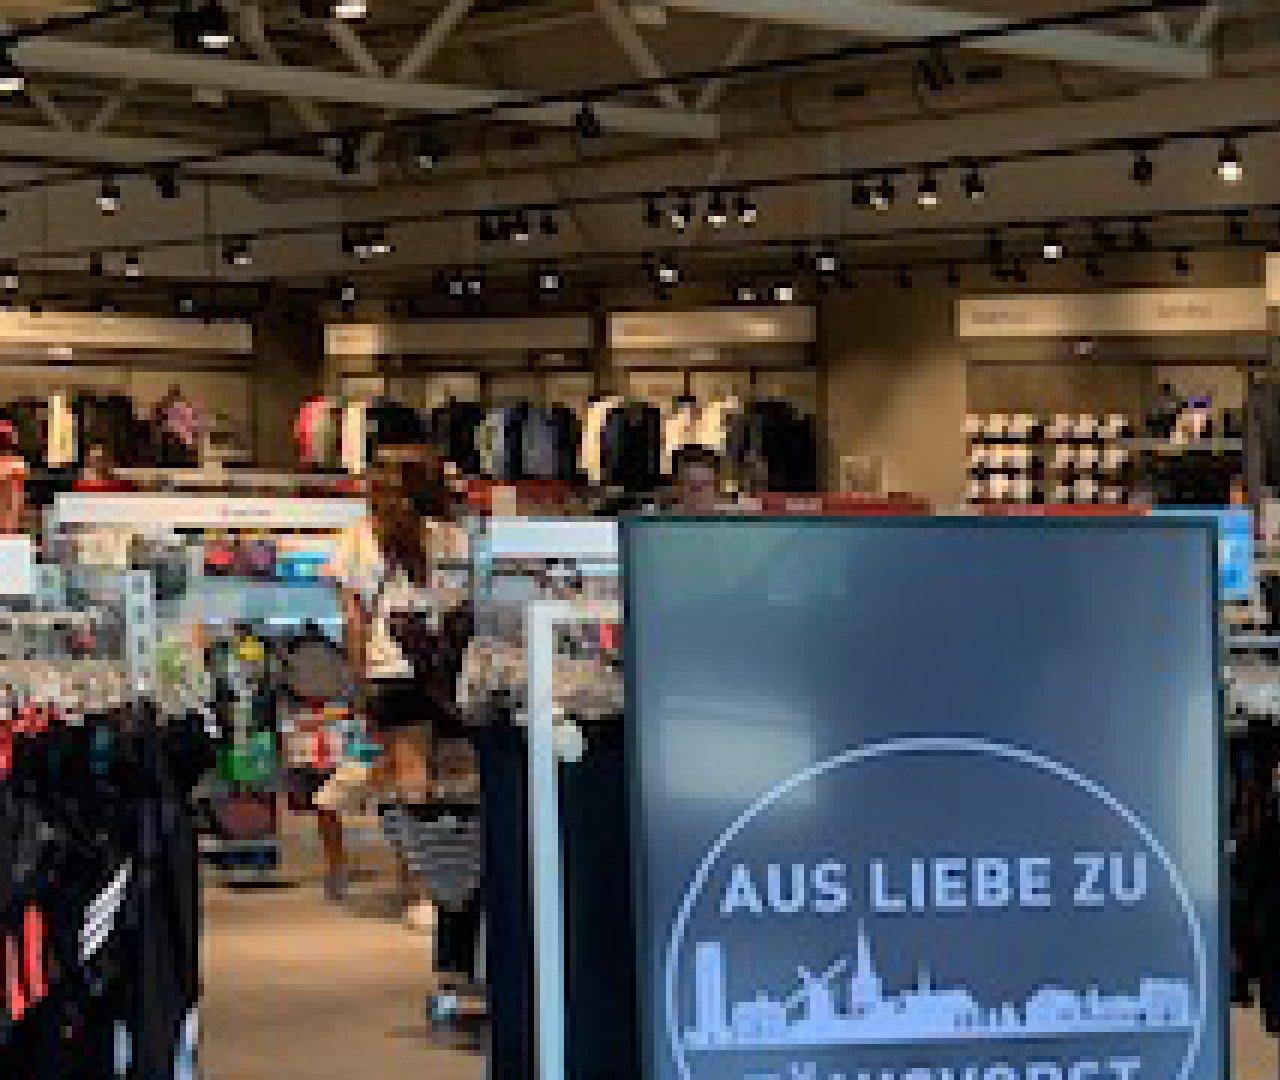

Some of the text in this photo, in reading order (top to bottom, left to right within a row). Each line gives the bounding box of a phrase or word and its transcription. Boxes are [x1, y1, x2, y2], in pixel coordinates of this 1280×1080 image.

[720, 852, 1148, 913] AUS LIEBE ZU
